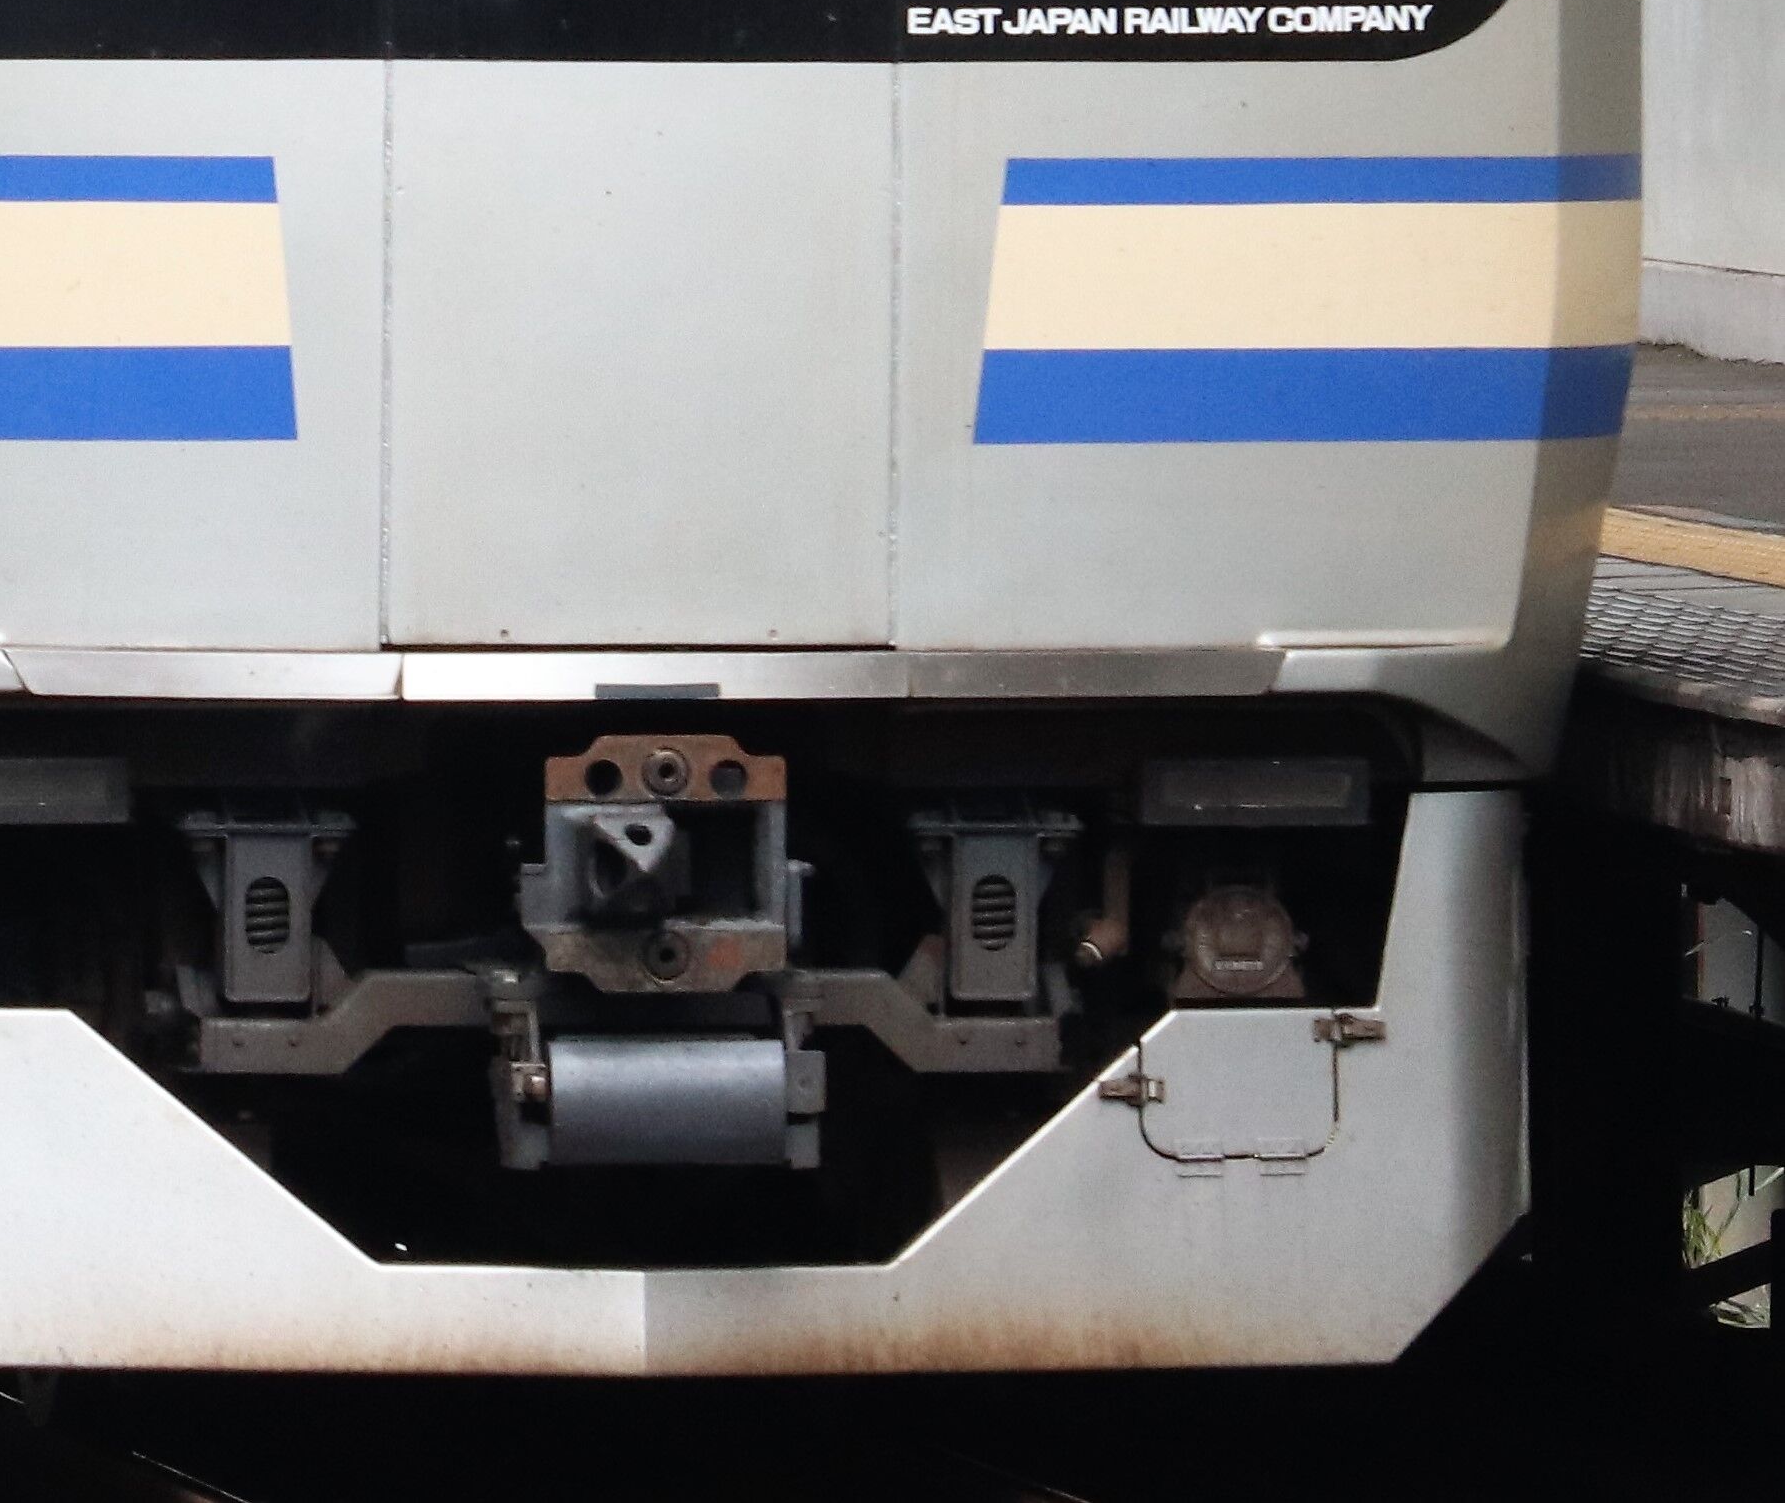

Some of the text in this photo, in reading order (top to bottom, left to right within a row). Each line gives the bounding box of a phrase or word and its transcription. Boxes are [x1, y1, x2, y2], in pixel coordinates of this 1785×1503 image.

[907, 4, 1433, 35] EAST JAPAN RAILWAY COMPANY
